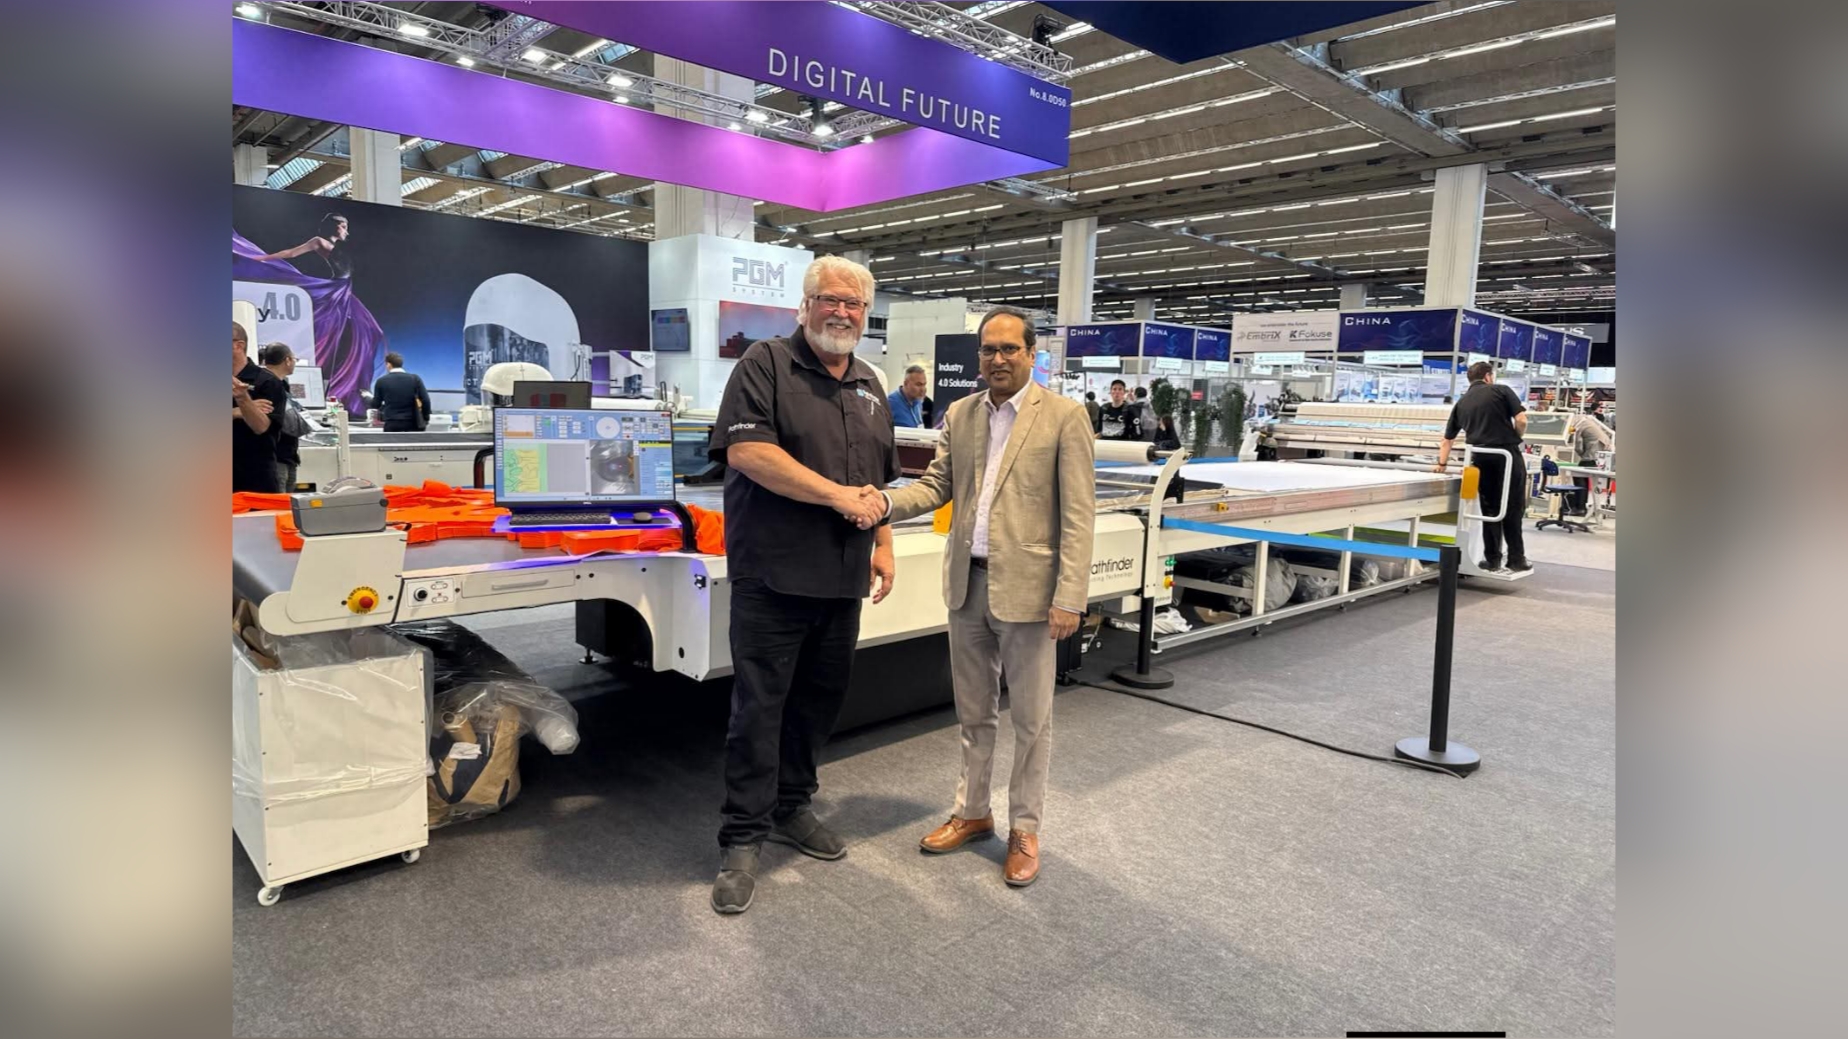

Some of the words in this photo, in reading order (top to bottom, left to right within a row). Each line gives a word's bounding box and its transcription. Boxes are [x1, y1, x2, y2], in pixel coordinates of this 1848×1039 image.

[769, 48, 890, 107] DIGITAL
[902, 88, 1001, 139] FUTURE
[732, 256, 785, 288] PGM
[263, 291, 301, 321] 4.0
[1344, 316, 1391, 326] CHINA
[1070, 328, 1100, 337] CHINA
[1145, 326, 1168, 336] CHINA
[1197, 332, 1218, 341] CHINA
[469, 350, 493, 365] PGM
[938, 362, 964, 373] Industry
[948, 377, 978, 388] Solutions
[1090, 557, 1134, 575] athfinder
